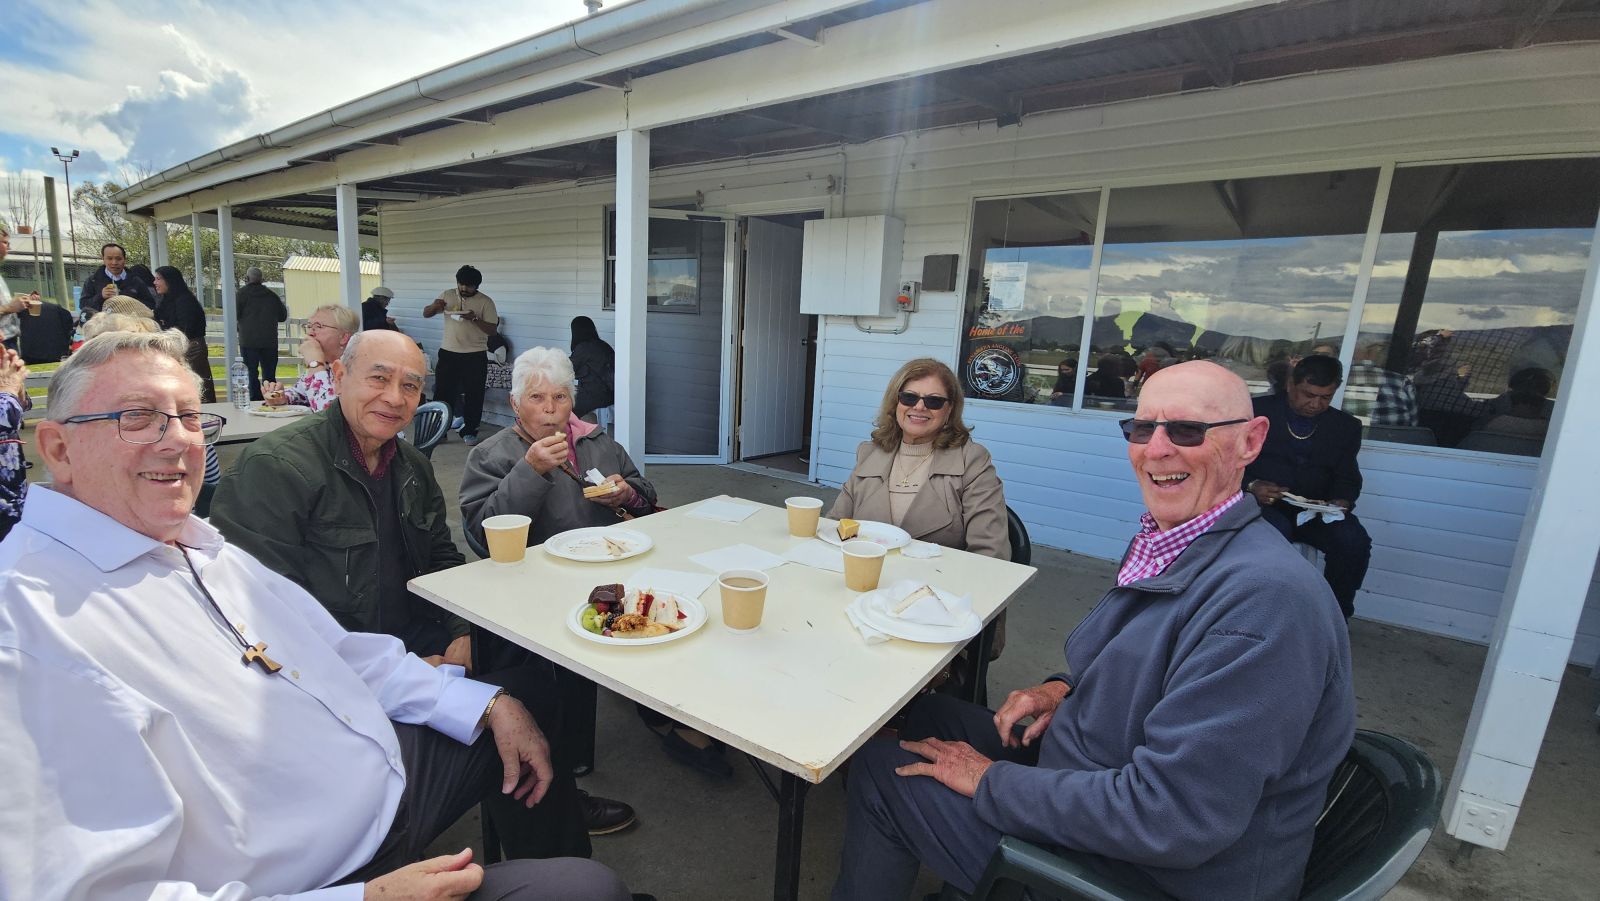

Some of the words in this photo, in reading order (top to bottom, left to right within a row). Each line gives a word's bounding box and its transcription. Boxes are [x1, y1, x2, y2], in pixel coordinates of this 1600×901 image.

[969, 326, 995, 336] Home
[997, 325, 1008, 335] of
[1009, 324, 1024, 334] the
[992, 343, 1013, 355] ANGLING
[1012, 352, 1022, 368] CLUB
